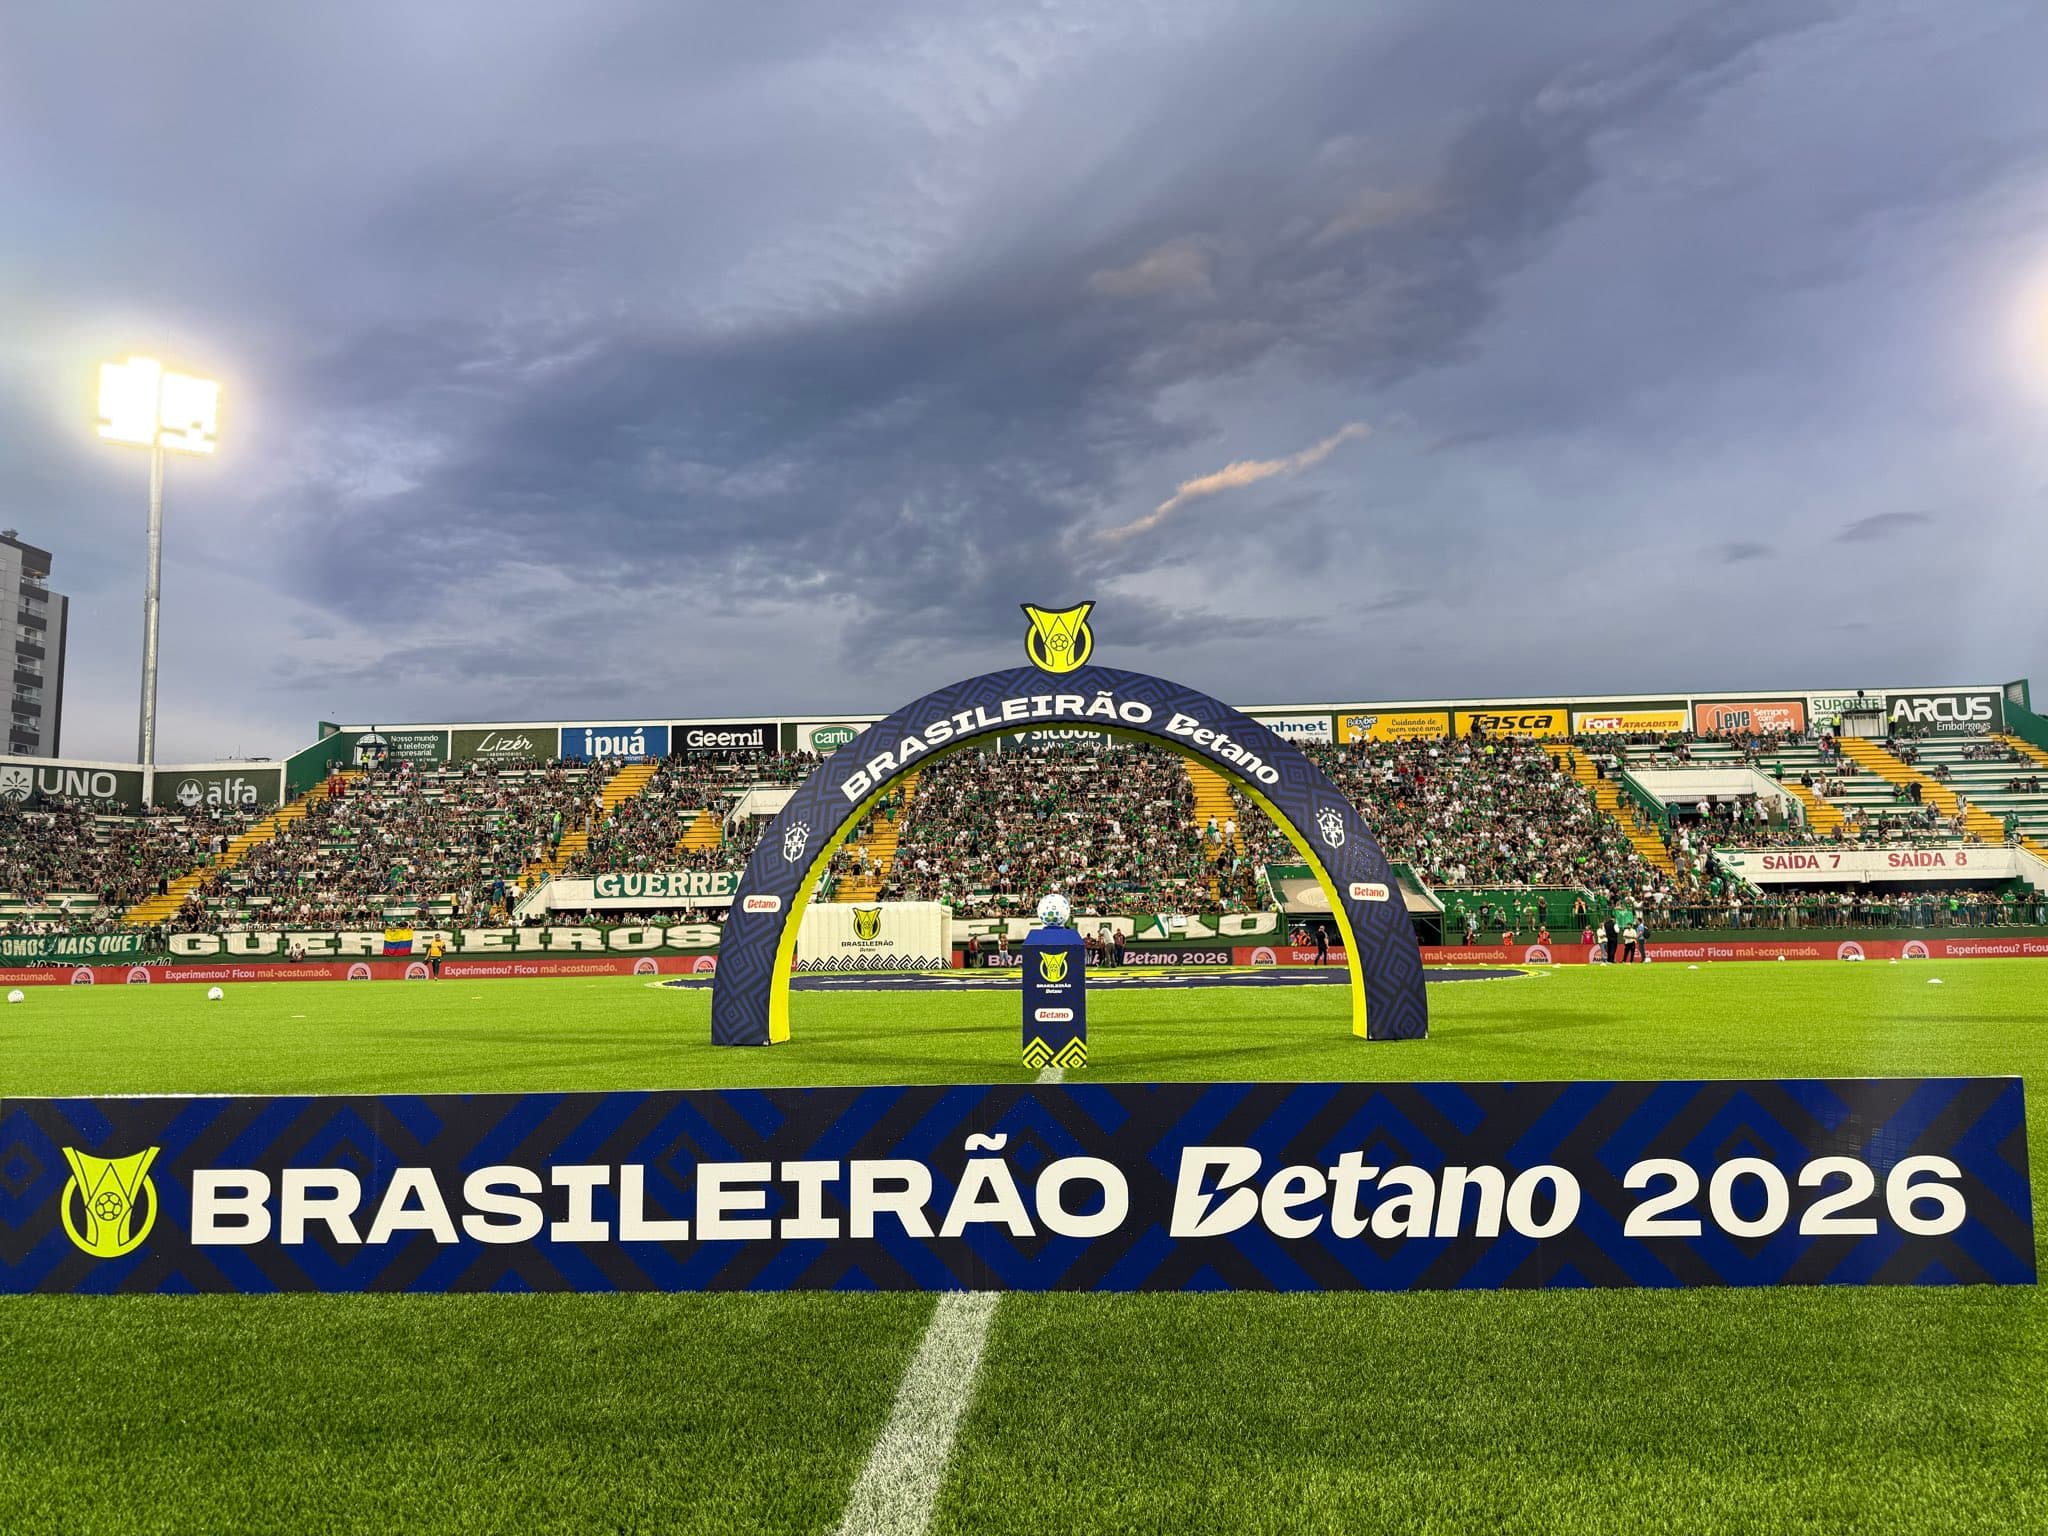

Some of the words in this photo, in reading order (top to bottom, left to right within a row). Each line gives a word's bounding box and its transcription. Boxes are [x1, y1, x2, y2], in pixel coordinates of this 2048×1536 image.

[1753, 708, 1789, 716] Sempre
[1814, 699, 1879, 711] SUPORTE
[1893, 696, 1993, 722] ARCUS
[1468, 714, 1553, 729] Tasca
[1585, 718, 1620, 729] Fort
[1622, 720, 1679, 728] ATACADISTA
[1715, 710, 1751, 730] Leve
[414, 734, 439, 742] mundo
[686, 728, 764, 747] Geemil
[814, 729, 854, 744] cantu
[403, 742, 436, 750] telefonia
[585, 727, 646, 761] ipuá
[840, 690, 1153, 802] BRASILEIRÃO
[1165, 712, 1279, 784] Betano
[390, 749, 432, 757] empresarial
[38, 768, 117, 797] UNO
[206, 778, 257, 805] alfa
[1762, 853, 1820, 870] SAÍDA
[1828, 854, 1841, 869] 7
[1888, 851, 1946, 868] SAÍDA
[1955, 851, 1968, 866] 8
[99, 935, 134, 955] QUE
[1946, 944, 2020, 955] Experimentou?
[1123, 951, 1178, 965] Betano
[1182, 952, 1228, 964] 2026
[1425, 950, 1508, 961] mal-acostumado.
[1634, 947, 1704, 959] Eperimentou?
[1708, 947, 1733, 957] Ficou
[1736, 946, 1820, 957] mal-acostumado.
[165, 969, 231, 981] Experimentou?
[232, 969, 255, 978] Ficou
[257, 968, 333, 978] mal-acostumado.
[444, 965, 511, 977] Experimentou?
[514, 965, 538, 974] Ficou
[540, 963, 618, 973] mal-acostumado.
[1039, 1011, 1069, 1019] Betano
[191, 1133, 1129, 1245] BRASILEIRÃO
[1168, 1145, 1580, 1239] Betano
[1623, 1154, 1967, 1237] 2026
